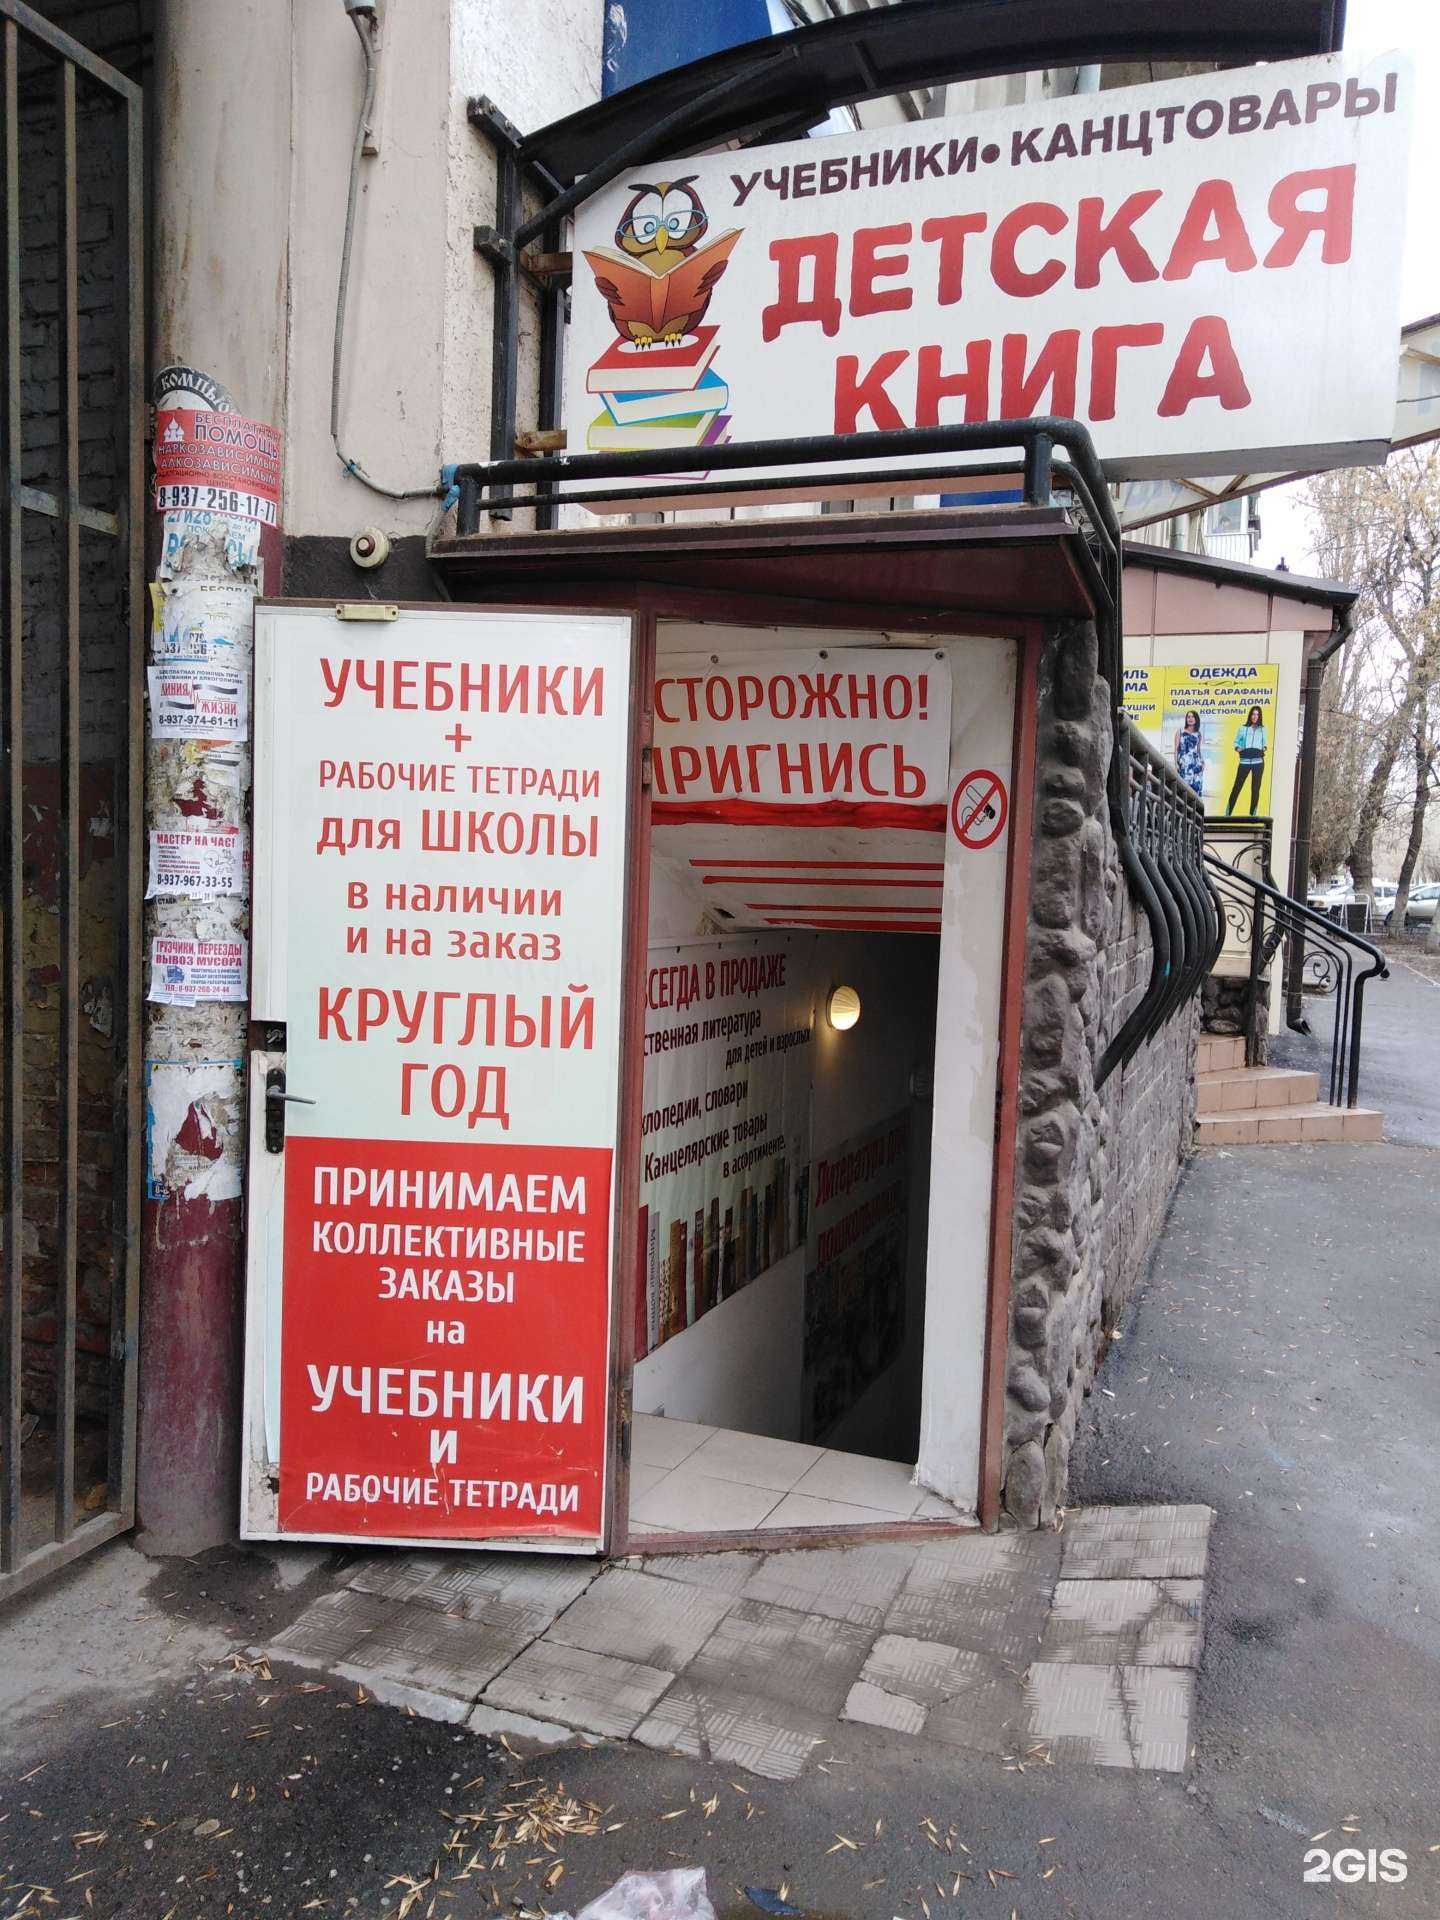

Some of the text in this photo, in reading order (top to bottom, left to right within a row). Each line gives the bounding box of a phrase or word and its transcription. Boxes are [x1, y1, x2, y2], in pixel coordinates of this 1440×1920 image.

[731, 72, 1398, 207] УЧЕБНИКИ КАНЦТОВАРЫ
[762, 164, 1357, 342] ДЕТСКАЯ
[834, 315, 1252, 436] КНИГА
[195, 424, 279, 459] ПОМОЩЬ
[158, 485, 276, 525] 8-937-256-17-77
[160, 682, 191, 697] ЛИНИЯ
[319, 657, 604, 716] УЧЕБНИКИ
[1189, 667, 1258, 679] ОДЕЖДА
[201, 700, 238, 716] ЖИЗНИ
[654, 673, 929, 723] СТОРОЖНО!
[1170, 688, 1273, 696] ПЛАТЬЯ САРАФАНЫ
[1171, 698, 1216, 706] ОДЕЖДА
[1239, 698, 1271, 706] ДОМА
[158, 714, 239, 728] 8-937-974-61-11
[319, 760, 600, 802] РАБОЧИЕ ТЕТРАДИ
[156, 833, 236, 848] МАСТЕР НА ЧАС!
[317, 809, 598, 858] для ШКОЛЫ
[157, 873, 233, 888] 8-937-967-33-55
[347, 881, 562, 917] в наличии
[155, 954, 243, 967] ВЫВОЗ МУСОРА
[156, 940, 243, 957] ГРУЗЧИКИ, ПЕРЕЕЗДЫ
[346, 927, 562, 961] и на заказ
[645, 953, 787, 1011] СЕГДА В ПРОДАЖЕ
[317, 983, 595, 1051] КРУГЛЫЙ
[701, 1008, 762, 1042] литература
[725, 1045, 743, 1070] для
[744, 1035, 768, 1064] детей
[776, 1028, 812, 1054] взрослых
[400, 1063, 510, 1130] ГОД
[705, 1079, 749, 1113] словари
[644, 1112, 769, 1183] Канцелярские товары
[723, 1162, 730, 1178] в
[313, 1166, 587, 1215] ПРИНИМАЕМ
[312, 1221, 586, 1263] КОЛЛЕКТИВНЫЕ
[378, 1266, 514, 1304] ЗАКАЗЫ
[426, 1320, 465, 1345] на
[307, 1364, 584, 1424] УЧЕБНИКИ
[429, 1429, 458, 1464] И
[306, 1472, 579, 1516] РАБОЧИЕ ТЕТРАДИ
